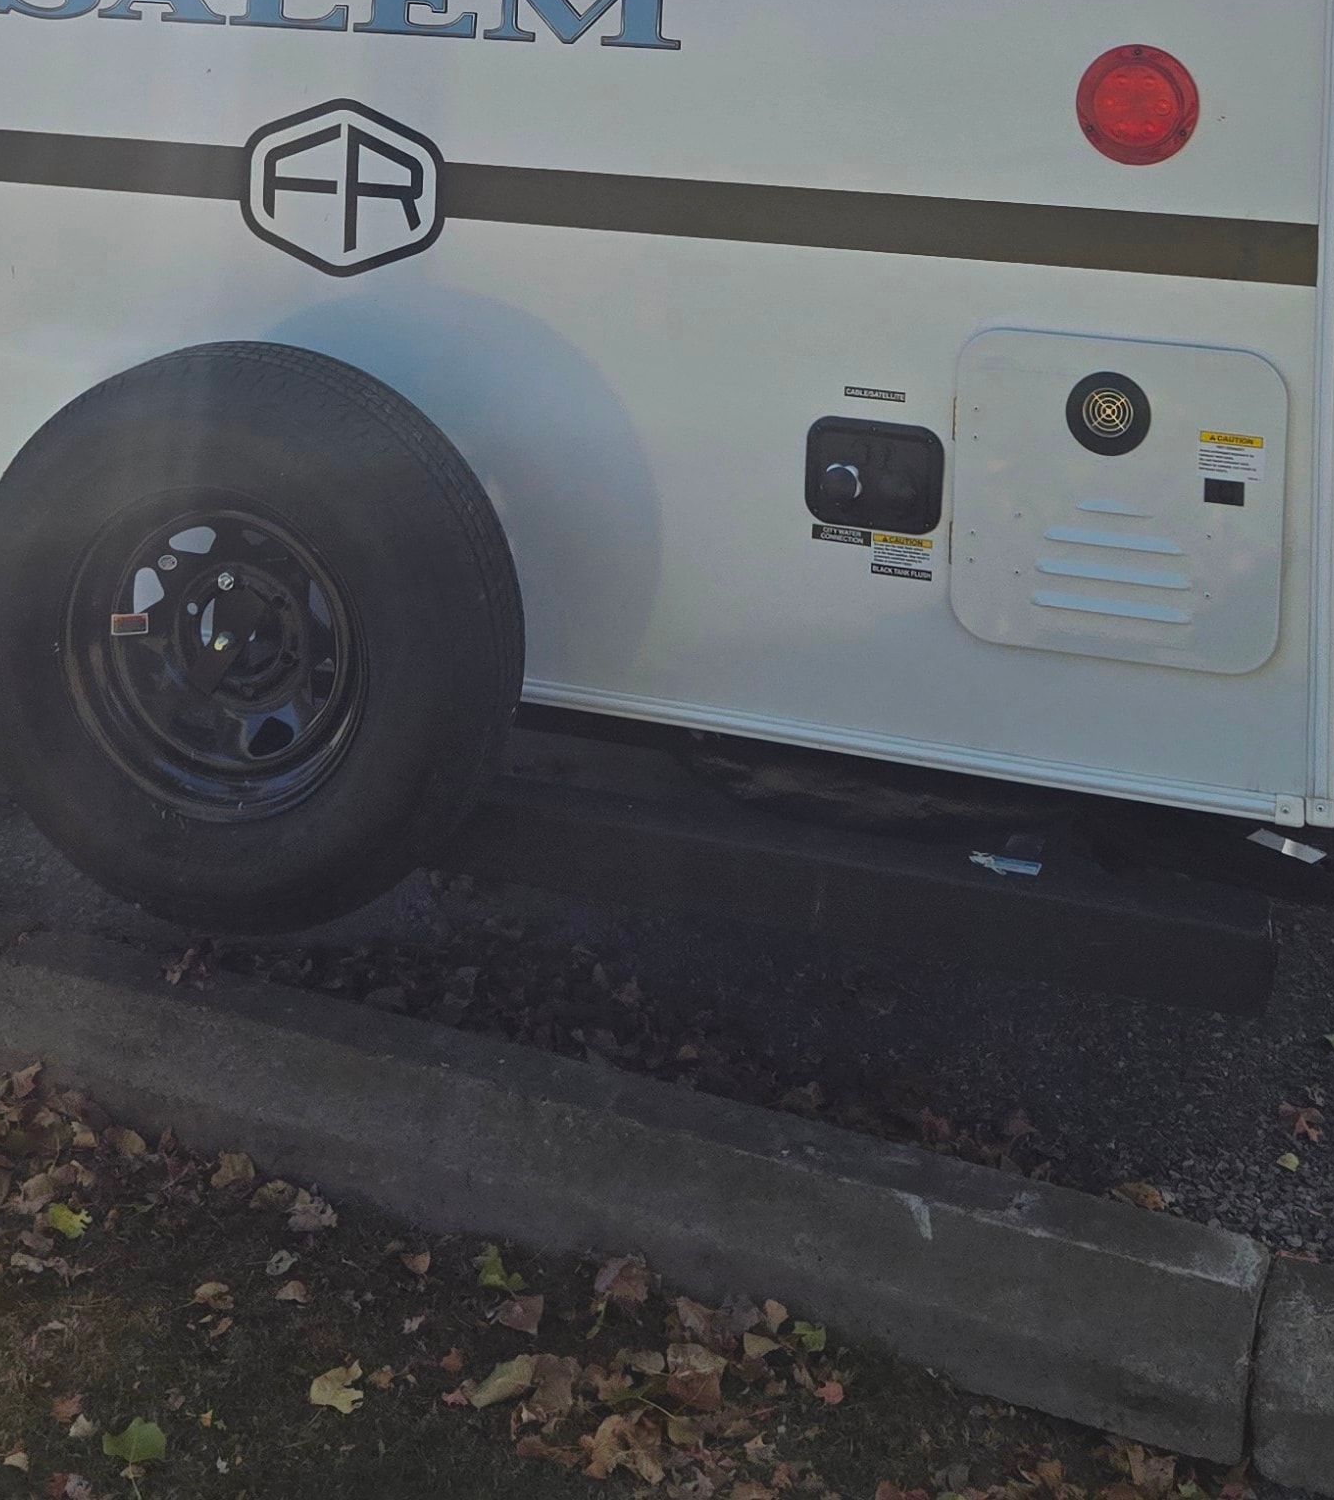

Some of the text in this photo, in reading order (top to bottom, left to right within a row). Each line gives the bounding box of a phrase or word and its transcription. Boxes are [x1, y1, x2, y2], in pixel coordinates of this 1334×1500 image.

[846, 387, 905, 401] CABLE/SATELLITE
[1217, 435, 1254, 445] CAUTION
[822, 526, 862, 537] CITY WATER
[820, 533, 864, 544] CONNECTION
[889, 535, 924, 547] CAUTION
[872, 565, 932, 579] BLACK TANK FLUSH
